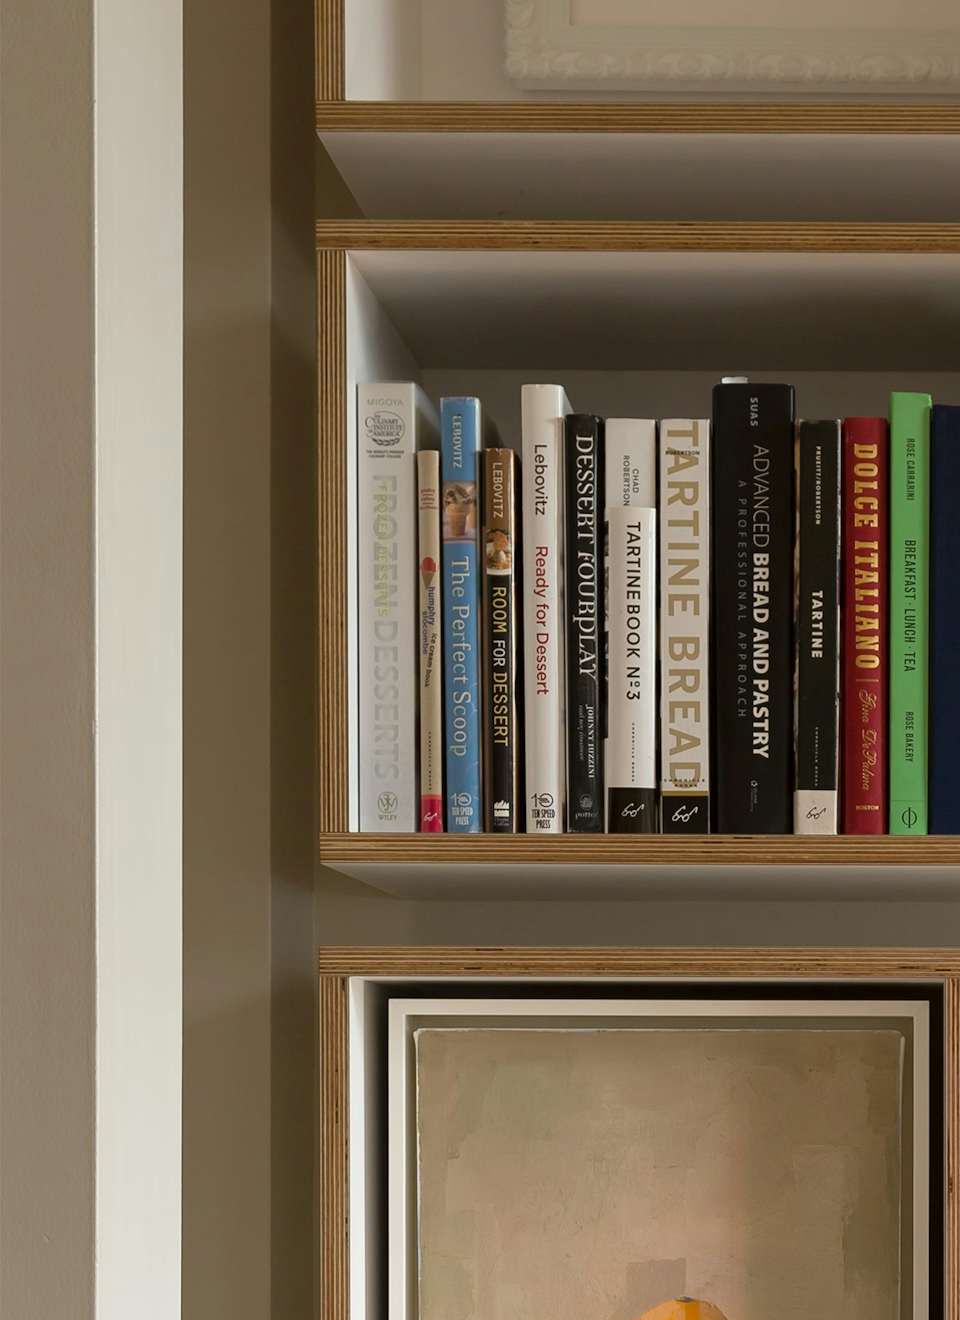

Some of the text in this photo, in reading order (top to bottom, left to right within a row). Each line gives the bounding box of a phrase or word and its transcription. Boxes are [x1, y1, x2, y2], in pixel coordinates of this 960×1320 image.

[452, 414, 463, 469] LEBOVITZ
[749, 396, 759, 426] SUAS
[492, 462, 504, 518] LEBOVITZ
[534, 444, 548, 516] Lebovitz
[622, 455, 631, 506] ROBERTSON
[632, 468, 640, 494] CHAD
[905, 437, 915, 501] ROSE CARRARINI
[572, 434, 597, 680] DESSERT FOURPLAY
[854, 443, 880, 669] DOLCE ITALIANO
[427, 586, 438, 626] humphry
[533, 545, 550, 695] Ready for Dessert
[667, 420, 701, 784] TARTINE BREAD
[737, 480, 747, 717] A PROFESSIONAL APPROACH
[752, 444, 770, 759] ADVANCED BREAD AND PASTRY
[811, 590, 823, 658] TARTINE
[903, 539, 916, 672] BREAKFAST LUNCH TEA
[450, 555, 471, 757] The Perfect Scoop
[493, 586, 508, 747] ROOM FOR DESSERT
[904, 711, 914, 762] ROSE BAKERY
